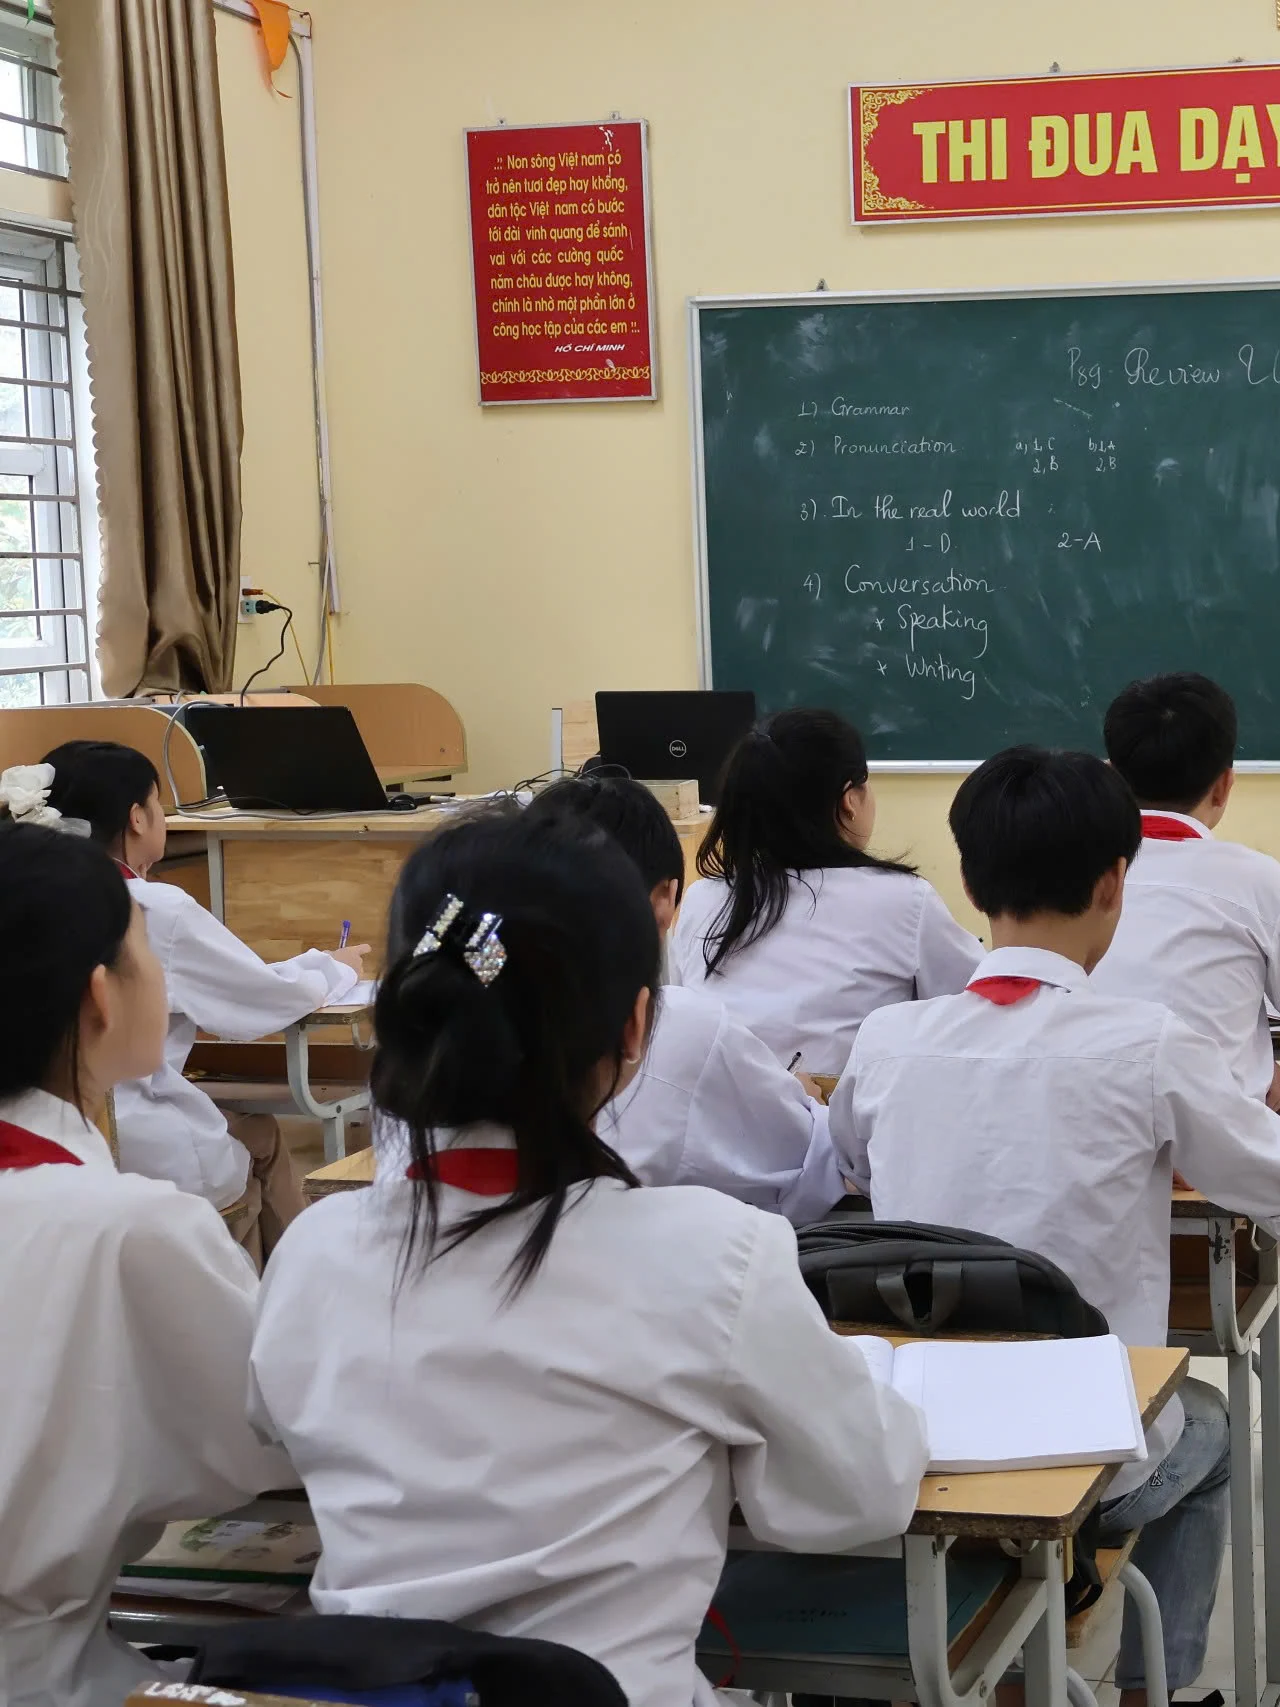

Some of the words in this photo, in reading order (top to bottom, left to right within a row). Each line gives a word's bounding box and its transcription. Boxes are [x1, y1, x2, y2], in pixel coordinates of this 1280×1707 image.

[913, 118, 1008, 184] THI
[1027, 112, 1157, 178] ĐUA
[507, 155, 528, 169] Non
[531, 154, 556, 171] sông
[558, 152, 578, 170] Việt
[581, 152, 604, 166] nam
[608, 149, 622, 164] có
[486, 177, 500, 194] trở
[503, 179, 521, 193] nên
[524, 178, 543, 192] tươi
[546, 177, 566, 195] đẹp
[570, 177, 588, 193] hay
[592, 176, 628, 192] không,
[488, 203, 507, 218] dân
[510, 203, 526, 221] tộc
[529, 201, 549, 219] Việt
[555, 203, 578, 215] nam
[582, 198, 594, 214] có
[598, 197, 624, 213] bước
[489, 226, 501, 241] tới
[504, 226, 520, 241] đài
[526, 226, 546, 240] vinh
[550, 228, 583, 242] quang
[586, 220, 600, 238] để
[603, 222, 627, 238] sánh
[490, 251, 505, 265] vai
[511, 249, 526, 264] với
[532, 248, 552, 264] các
[558, 247, 591, 266] cường
[597, 244, 624, 264] quốc
[491, 274, 513, 289] năm
[517, 273, 542, 288] châu
[545, 272, 572, 290] được
[575, 272, 594, 289] hay
[597, 271, 632, 288] không,
[492, 297, 520, 313] chính
[523, 296, 532, 312] là
[535, 296, 554, 311] nhờ
[558, 296, 577, 314] một
[580, 293, 606, 313] phần
[609, 294, 625, 310] lớn
[628, 293, 635, 309] ở
[493, 322, 519, 340] công
[522, 322, 541, 339] học
[544, 321, 561, 338] tập
[564, 318, 584, 335] của
[587, 319, 607, 334] các
[611, 321, 627, 333] em
[574, 344, 594, 352] CHÍ
[1124, 347, 1220, 385] Review
[831, 396, 910, 417] Grammar
[833, 436, 957, 454] Pronunciation
[831, 495, 863, 518] In
[875, 495, 904, 519] the
[910, 489, 952, 519] real
[962, 489, 1021, 518] world
[845, 564, 994, 595] Conversation
[897, 604, 988, 659] Speaking
[905, 653, 975, 700] Writing
